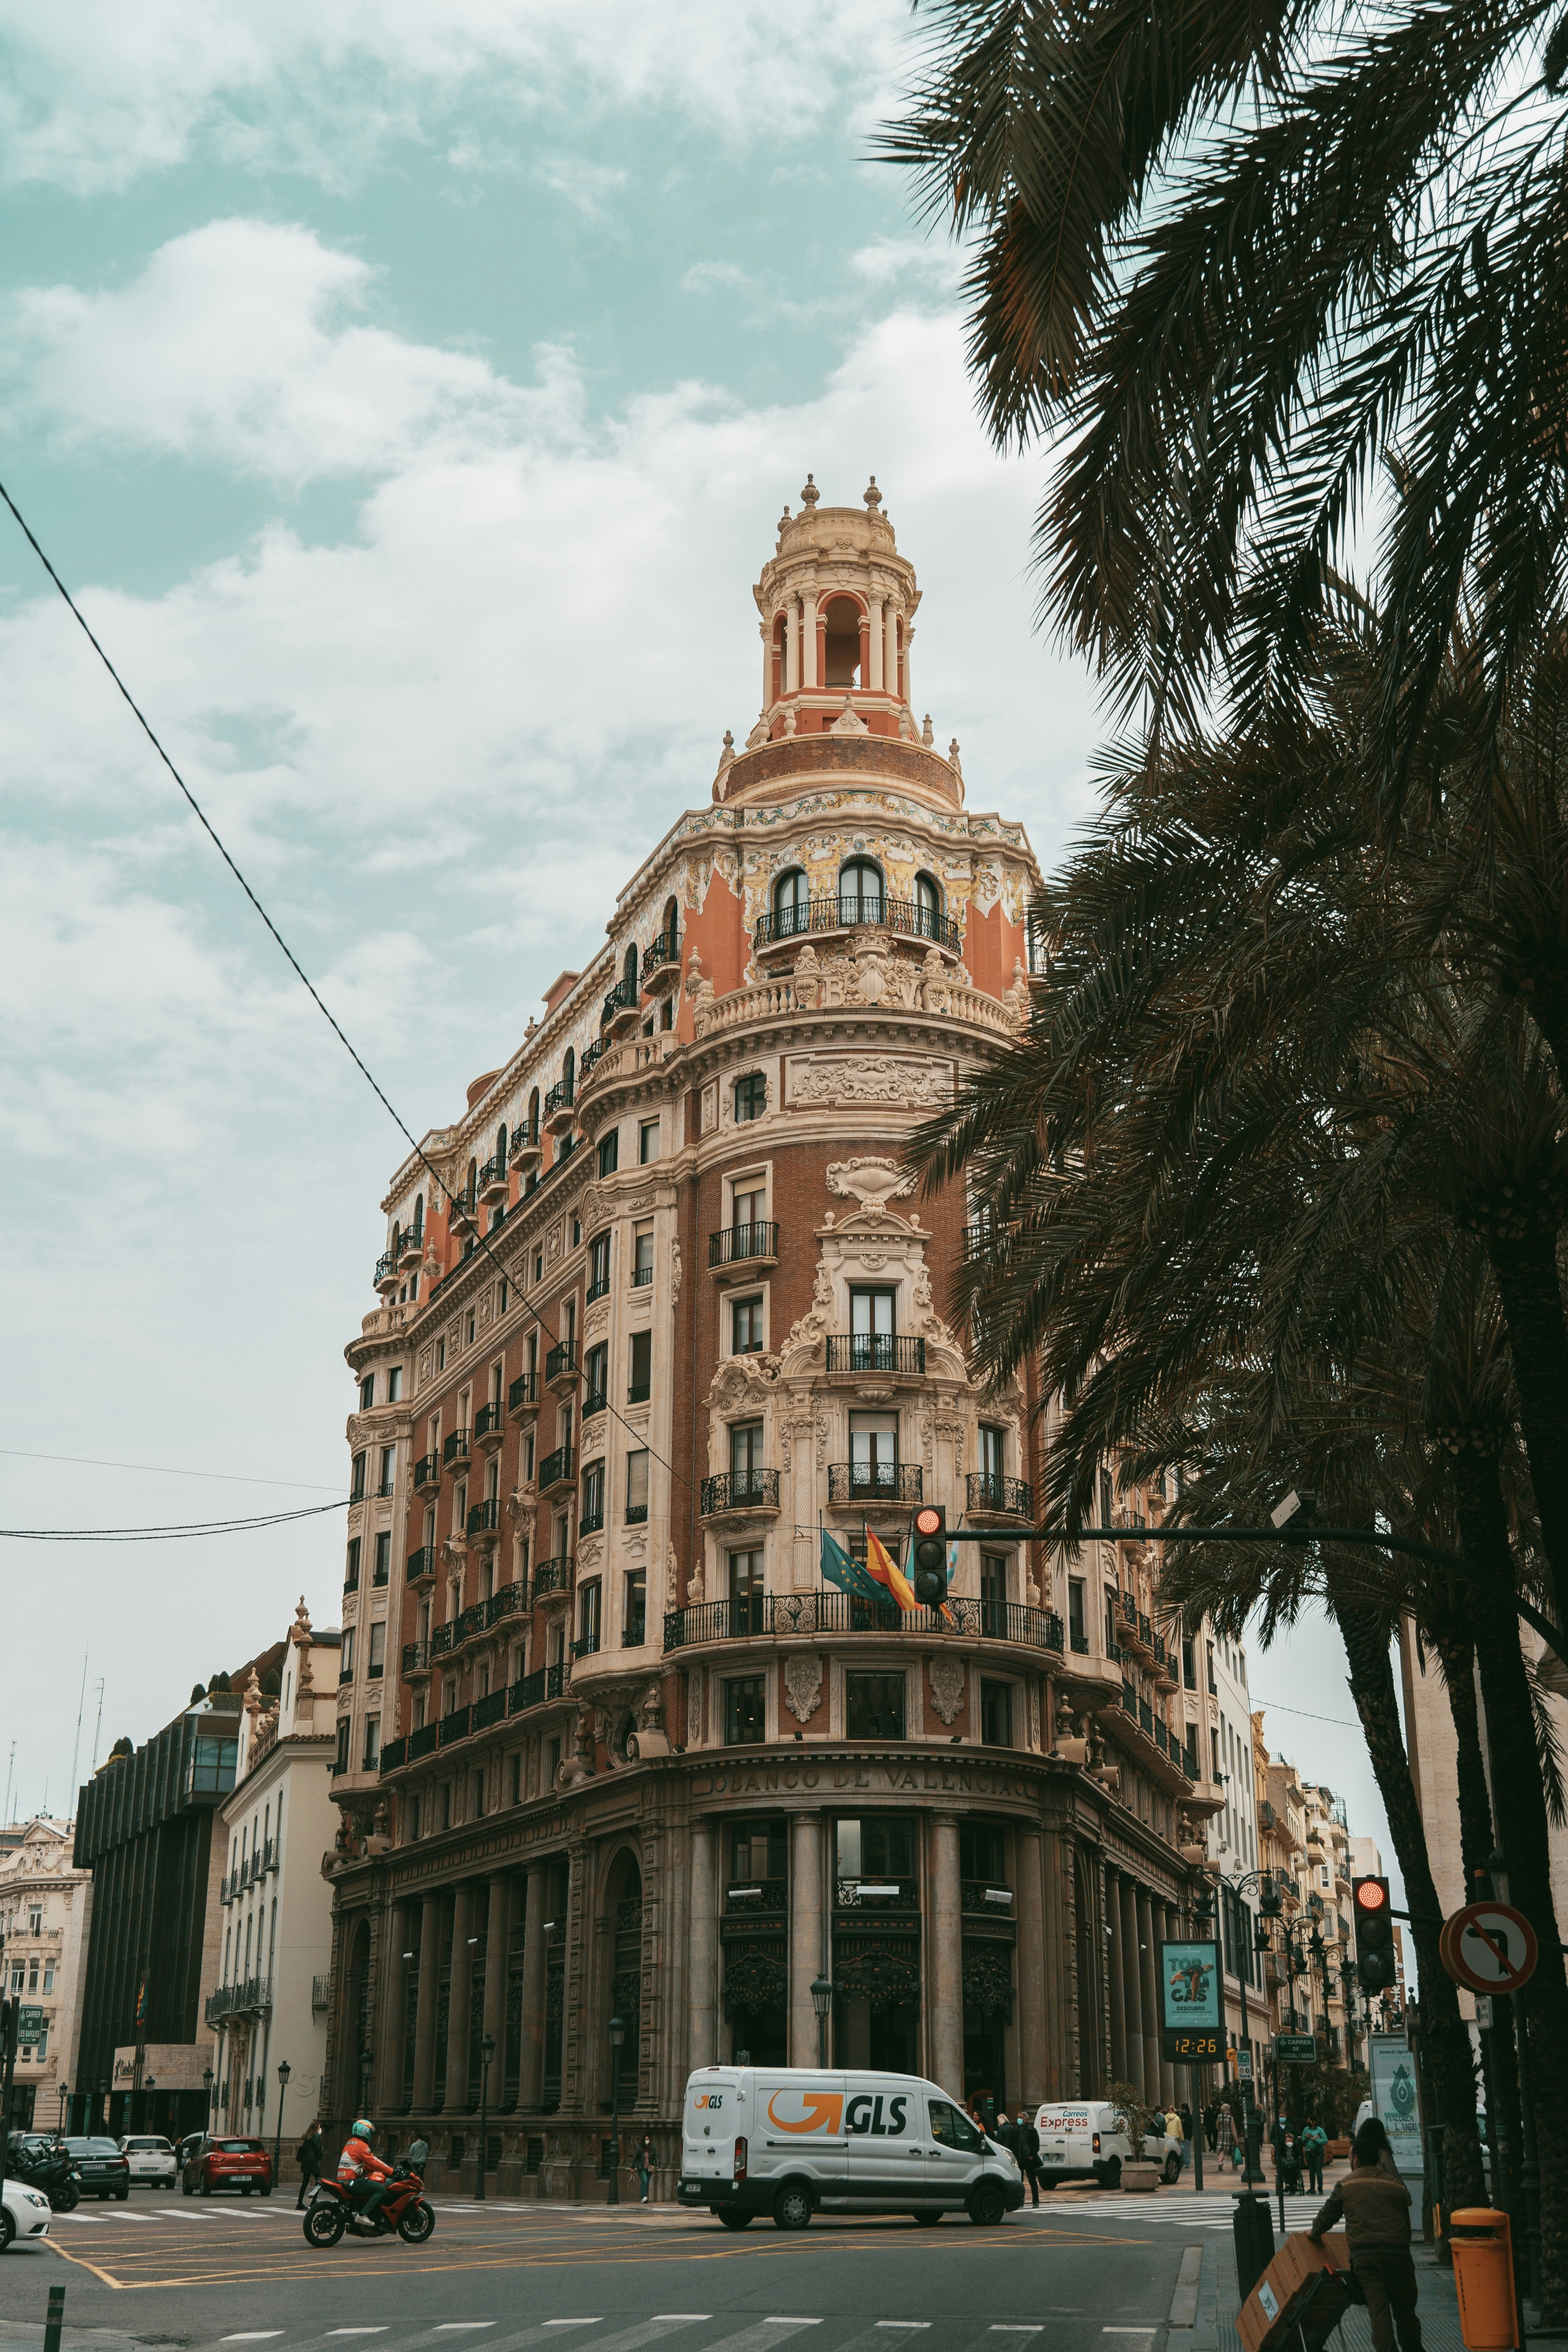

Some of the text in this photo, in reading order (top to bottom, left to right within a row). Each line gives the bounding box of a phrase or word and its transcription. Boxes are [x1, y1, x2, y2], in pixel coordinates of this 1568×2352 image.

[730, 1767, 1011, 1795] BANCO DE VALENCIA
[1168, 1957, 1203, 1971] TOR
[1171, 1988, 1207, 2002] GAS
[26, 2010, 41, 2018] CARRER
[1175, 2039, 1216, 2053] 12:26
[709, 2095, 723, 2109] GLS
[845, 2094, 907, 2135] GLS
[1040, 2117, 1088, 2129] Express
[1286, 2244, 1303, 2282] novoprint
[1272, 2262, 1288, 2300] novoprint
[1240, 2314, 1256, 2351] novoprint
